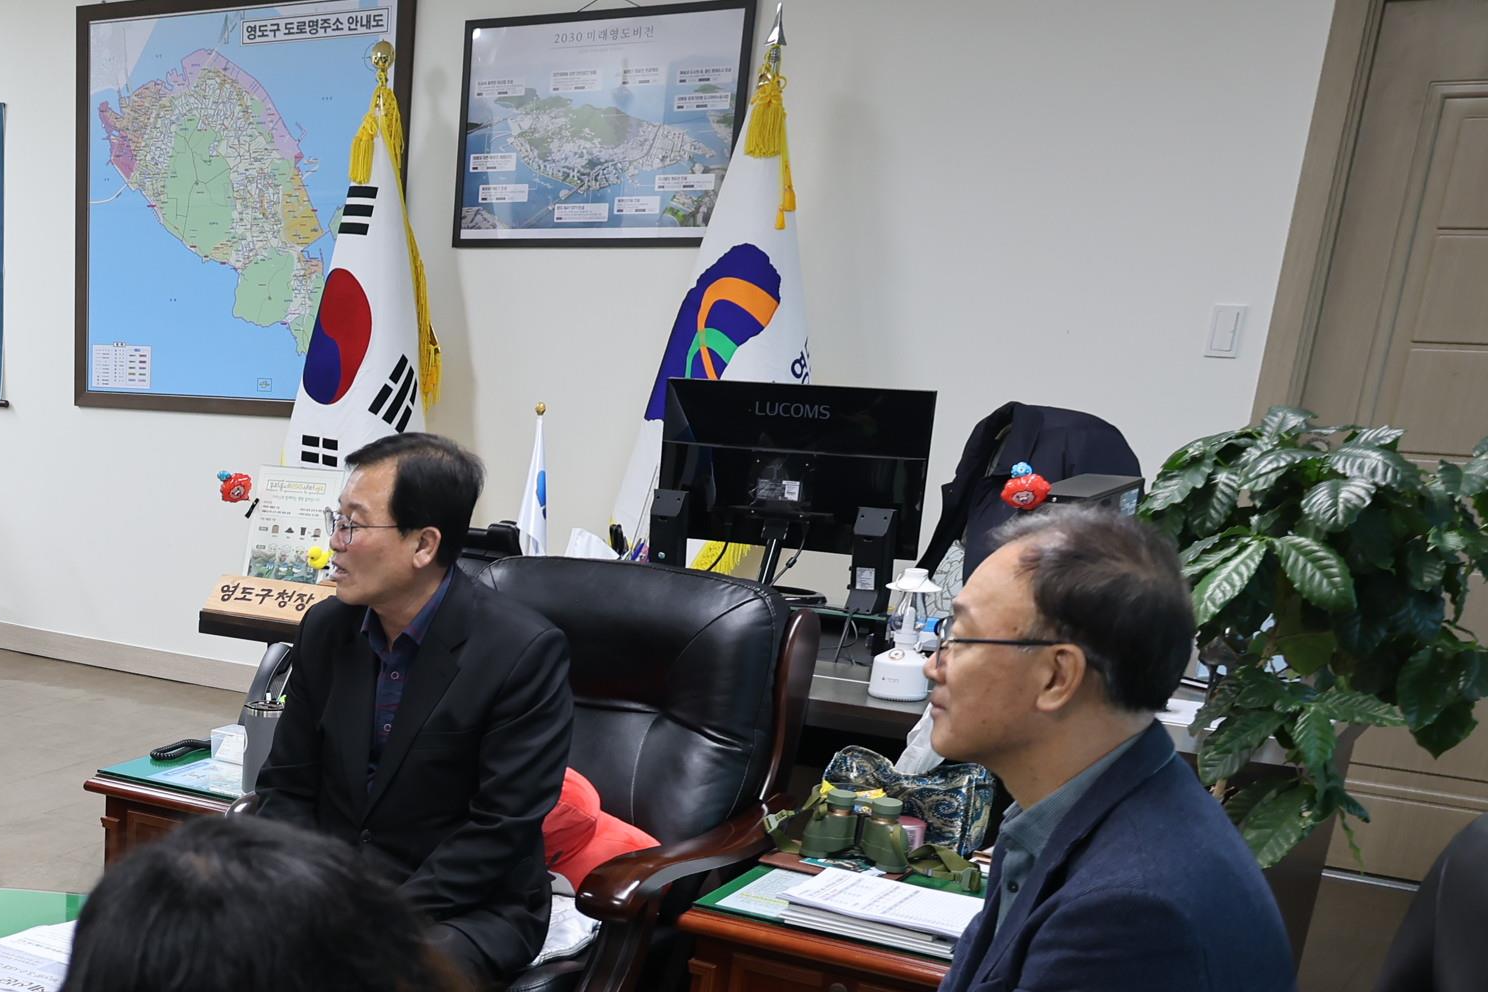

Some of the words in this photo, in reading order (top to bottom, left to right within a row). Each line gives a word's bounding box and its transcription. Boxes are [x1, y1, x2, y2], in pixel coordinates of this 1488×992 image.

[246, 22, 281, 40] 영도구
[283, 17, 344, 35] 도로명주소
[347, 13, 384, 31] 안내도
[554, 32, 583, 44] 2030
[755, 400, 831, 420] LUCOMS
[220, 582, 315, 612] 영도구청장
